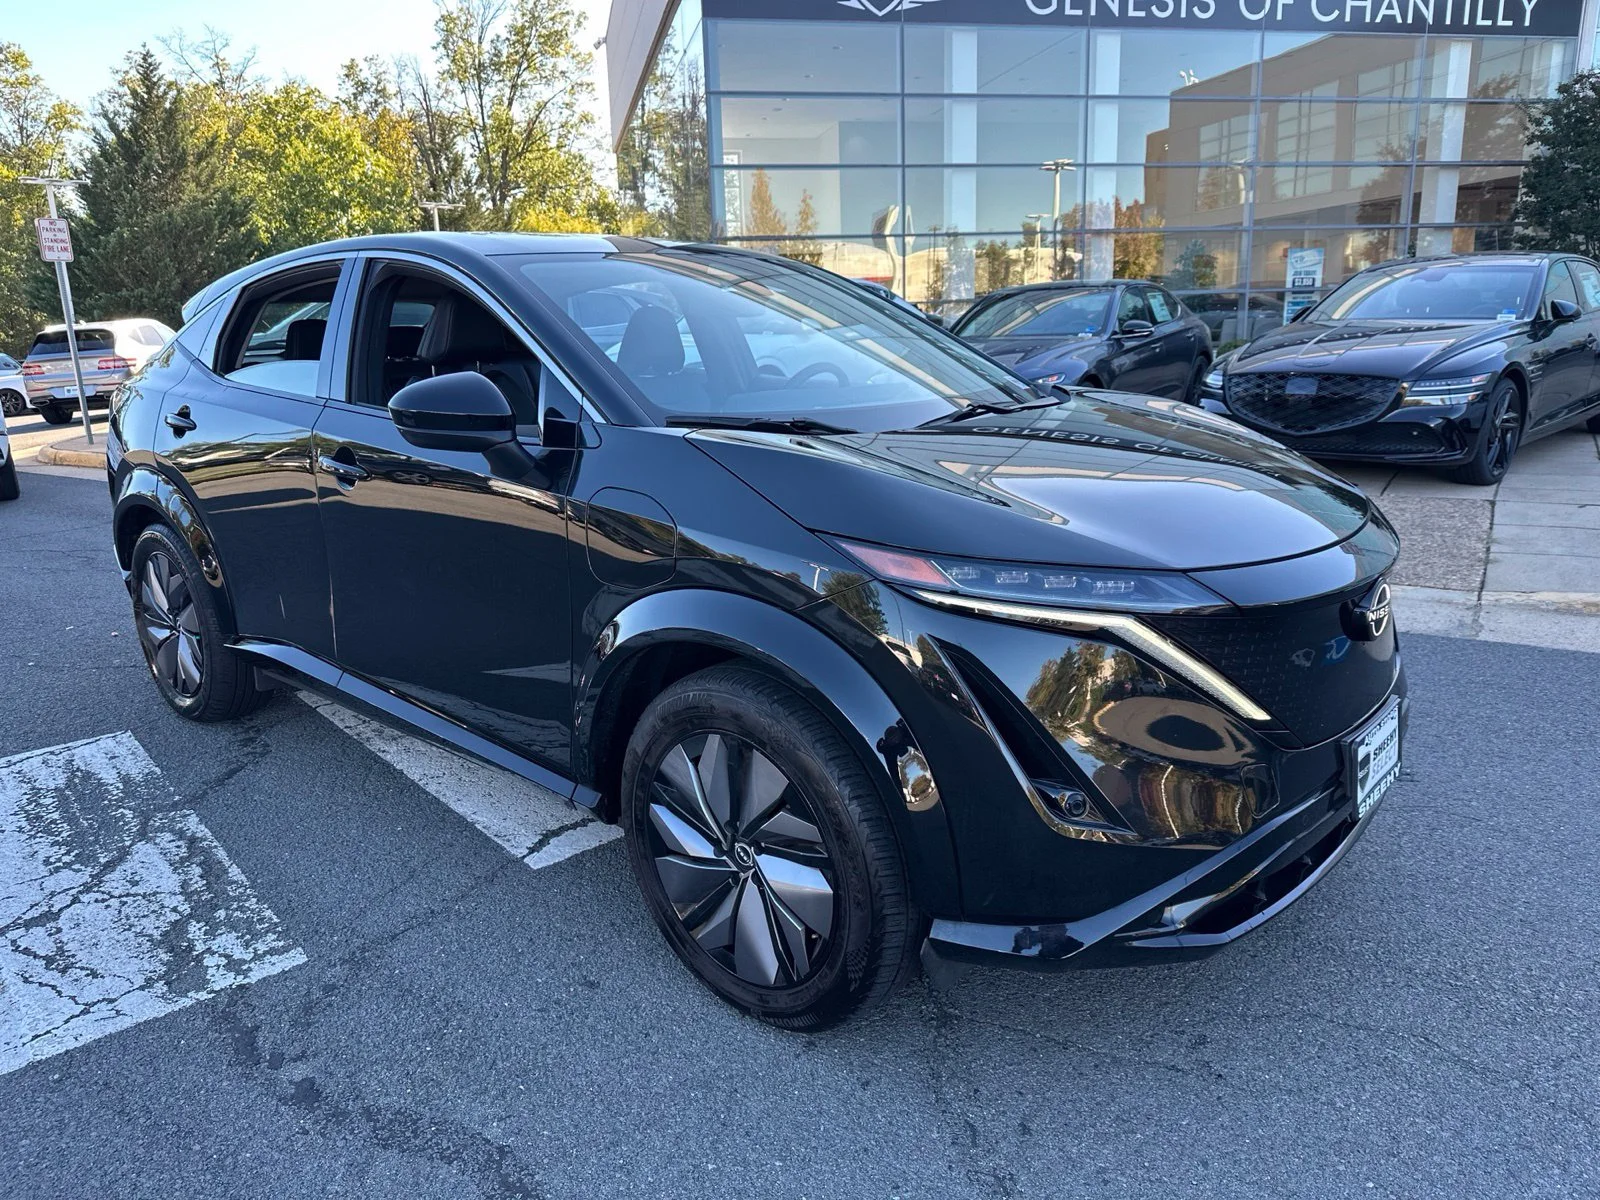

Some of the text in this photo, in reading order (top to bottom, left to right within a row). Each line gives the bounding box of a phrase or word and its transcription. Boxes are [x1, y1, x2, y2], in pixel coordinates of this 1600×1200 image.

[1239, 0, 1295, 20] OF
[1373, 724, 1397, 761] SHEEHY
[1358, 762, 1401, 819] SHEEHY
